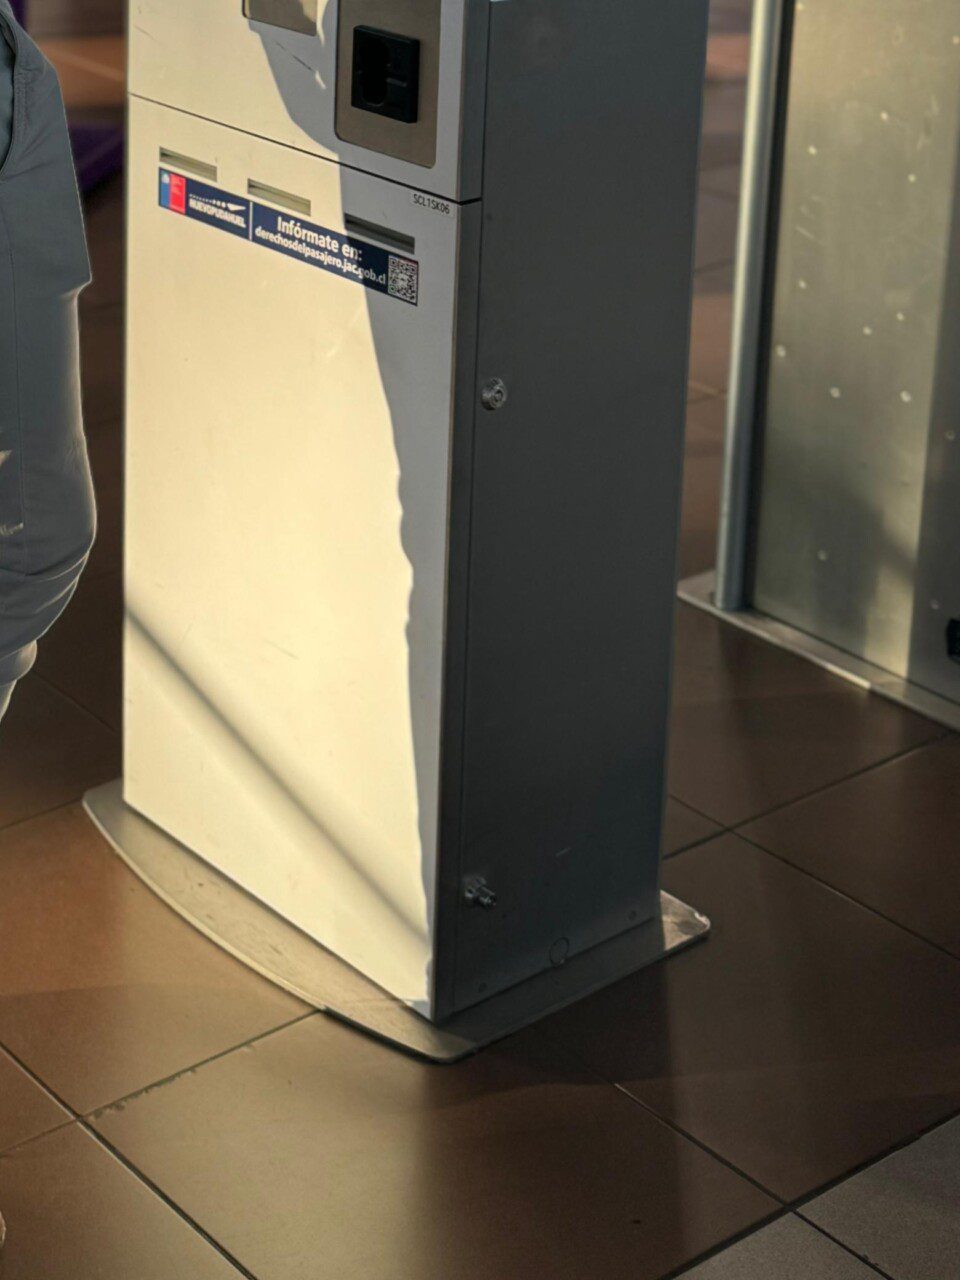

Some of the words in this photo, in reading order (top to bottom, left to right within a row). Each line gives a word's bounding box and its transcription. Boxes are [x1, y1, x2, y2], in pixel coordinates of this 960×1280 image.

[413, 193, 451, 215] SCL1SK06
[254, 225, 386, 285] derechosdelpasajero.jac.gob.cl
[277, 216, 340, 253] Infórmate
[341, 243, 363, 262] en:
